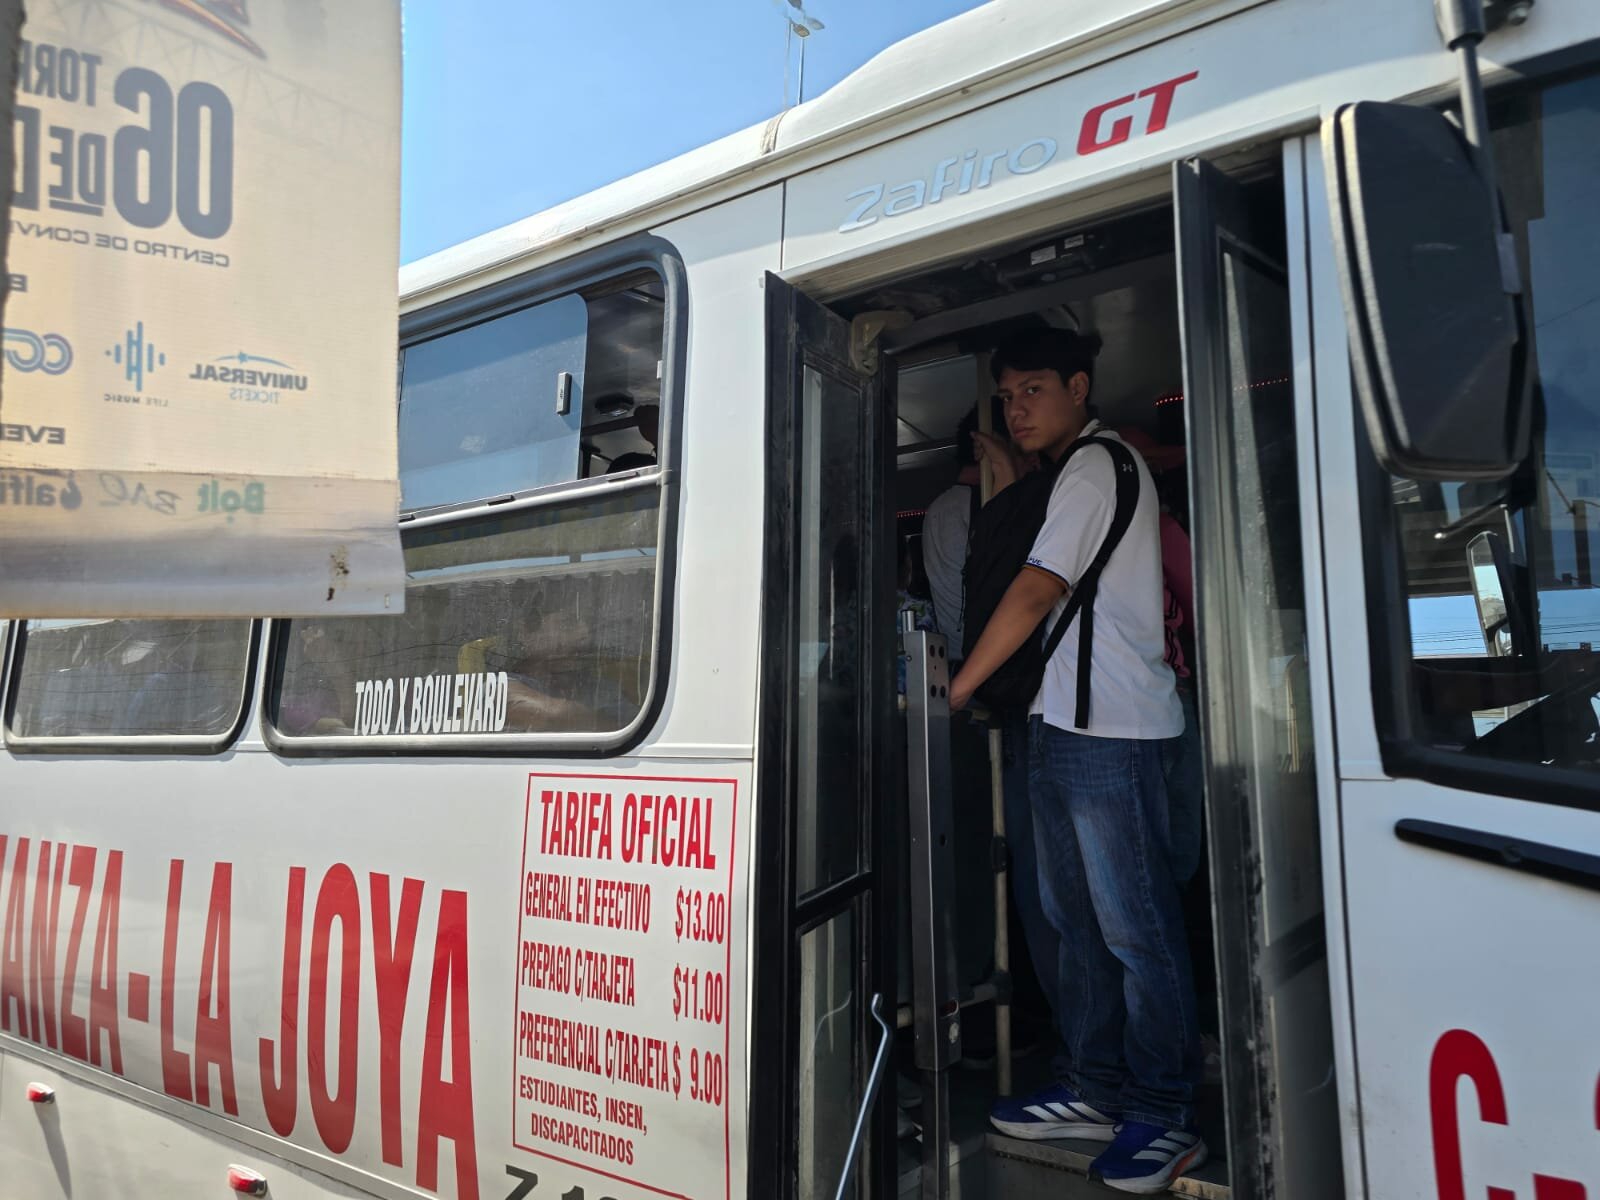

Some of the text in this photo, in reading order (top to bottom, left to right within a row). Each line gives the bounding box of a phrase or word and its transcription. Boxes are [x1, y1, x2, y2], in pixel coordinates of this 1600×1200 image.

[838, 70, 1199, 234] Zafiro GT
[353, 671, 509, 736] TODO X BOULEVARD
[541, 790, 716, 870] TARIFA OFICIAL
[525, 871, 725, 945] GENERAL EN EFECTIVO $13.00
[522, 940, 723, 1024] PREPAGO C/TARJETA $11.00
[259, 862, 480, 1200] JOYA
[519, 1010, 602, 1076] PREFERENCIAL
[605, 1028, 669, 1092] C/TARJETA
[519, 1075, 647, 1136] ESTUDIANTES, INSEN,
[531, 1112, 634, 1166] DISCAPACITADOS
